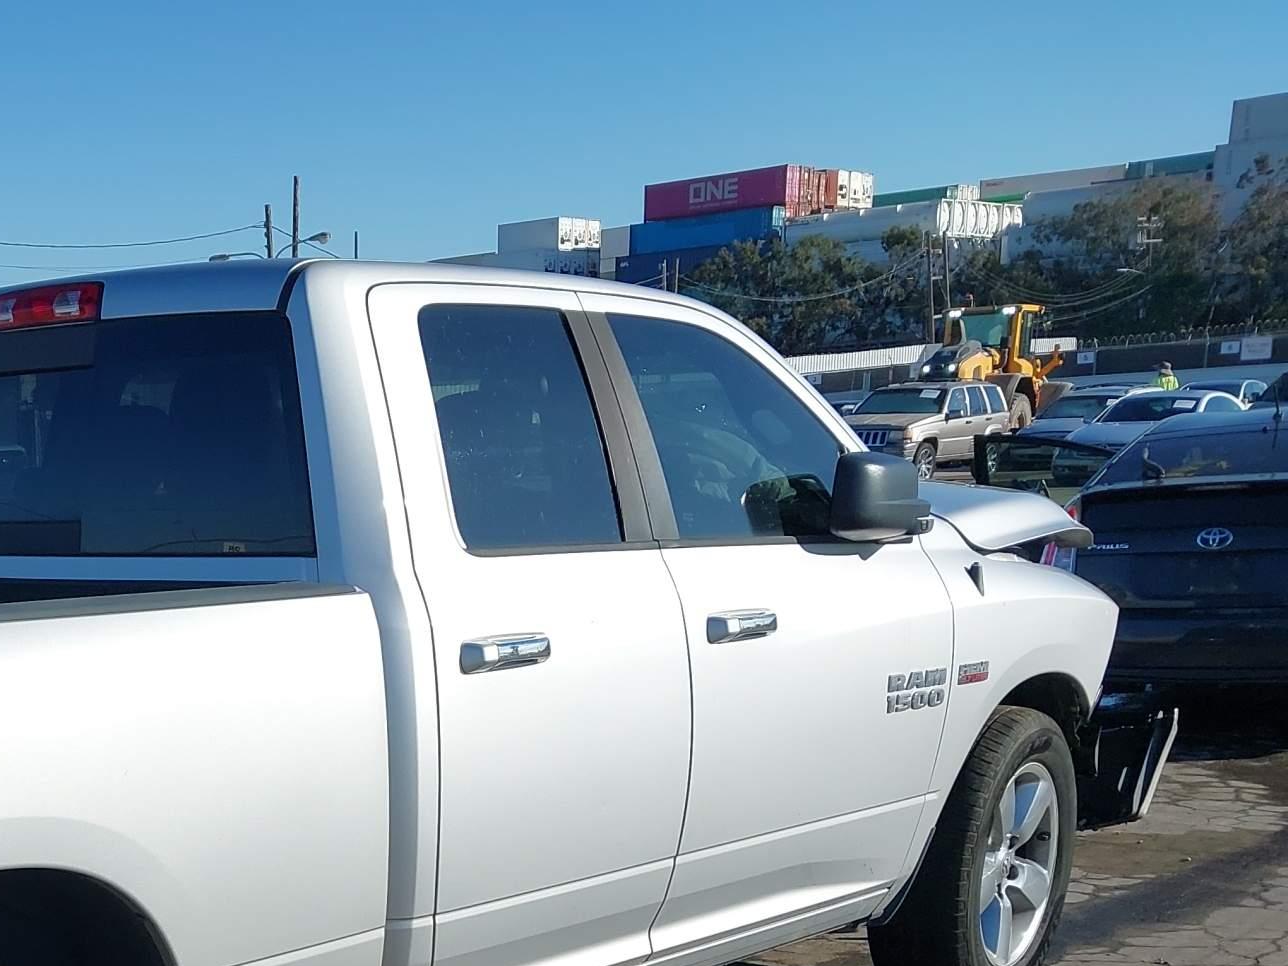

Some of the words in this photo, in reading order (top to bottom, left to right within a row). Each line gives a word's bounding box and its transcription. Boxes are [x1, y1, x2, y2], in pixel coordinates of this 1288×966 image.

[689, 177, 738, 204] ONE
[887, 667, 948, 693] RAM
[886, 688, 945, 714] 1500
